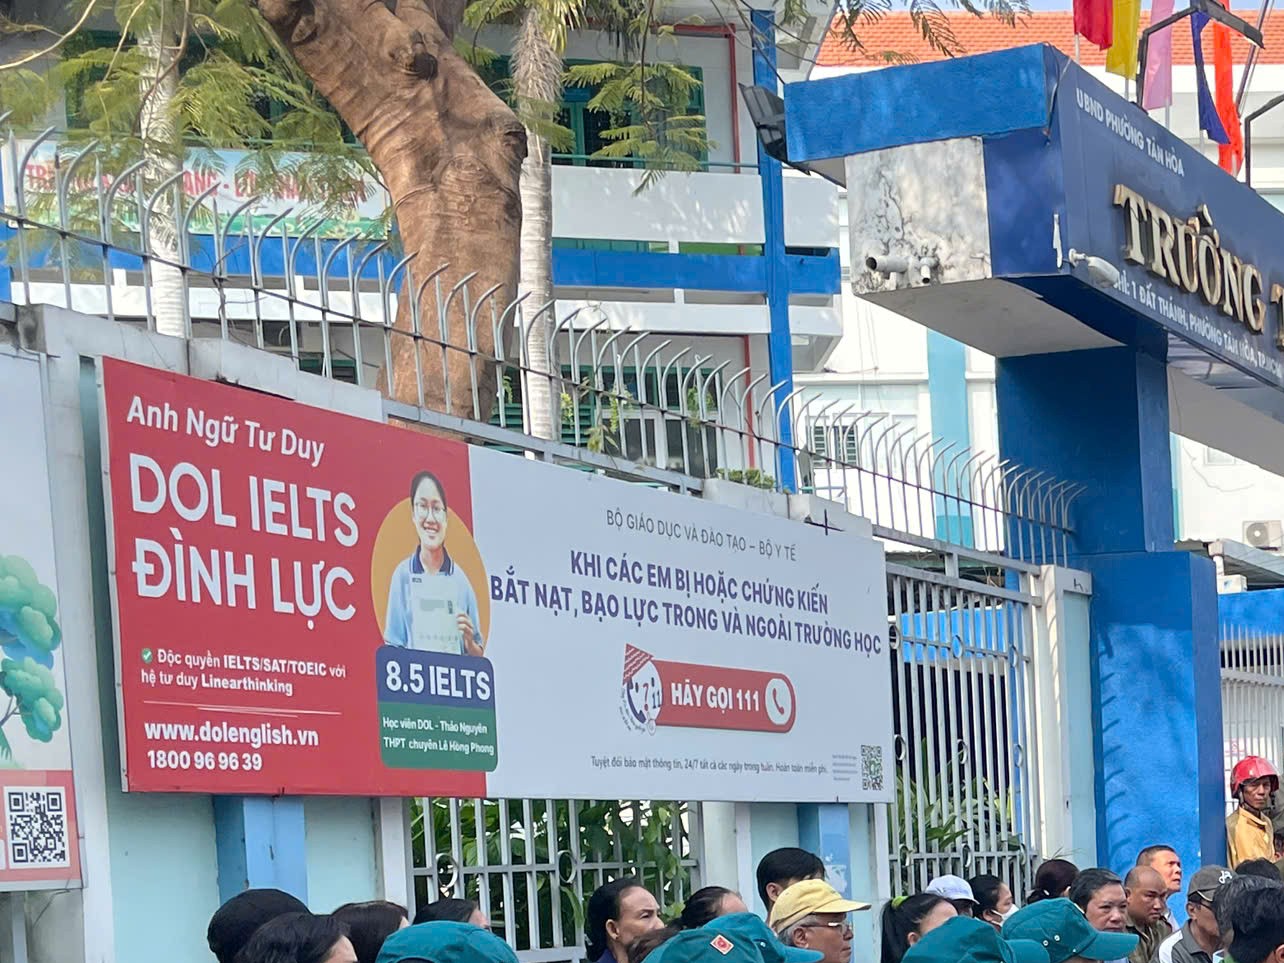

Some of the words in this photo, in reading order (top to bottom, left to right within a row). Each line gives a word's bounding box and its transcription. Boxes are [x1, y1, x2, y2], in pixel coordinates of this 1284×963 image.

[1076, 88, 1104, 122] UBND
[1105, 108, 1144, 150] PHƯỜNG
[1146, 136, 1164, 166] TÂN
[1165, 146, 1184, 177] HÒA
[1113, 184, 1266, 335] TRƯỜNG
[1131, 281, 1137, 299] 1
[1139, 282, 1156, 310] ĐẤT
[1190, 314, 1223, 346] PHƯỜNG
[127, 396, 178, 432] Anh
[186, 408, 238, 447] Ngữ
[245, 420, 275, 451] Tư
[281, 429, 324, 467] Duy
[130, 453, 236, 527] DOL
[249, 476, 358, 547] IELTS
[607, 507, 623, 530] BỘ
[626, 512, 654, 533] GIÁO
[658, 520, 681, 540] DỤC
[684, 523, 698, 541] VÀ
[701, 525, 723, 547] ĐÀO
[727, 533, 746, 553] TẠO
[759, 538, 772, 559] BỘ
[775, 545, 781, 558] Y
[784, 543, 797, 561] TẾ
[132, 527, 256, 609] ĐÌNH
[271, 558, 356, 629] LỰC
[570, 550, 601, 578] KHI
[606, 553, 643, 584] CÁC
[647, 563, 672, 590] EM
[676, 567, 690, 598] BỊ
[694, 570, 737, 603] HOẶC
[742, 577, 794, 609] CHỨNG
[798, 582, 828, 615] KIẾN
[490, 565, 529, 605] BẮT
[582, 590, 619, 622] BẠO
[624, 597, 658, 627] LỰC
[662, 601, 718, 631] TRONG
[722, 607, 743, 635] VÀ
[746, 613, 791, 641] NGOÀI
[795, 620, 851, 650] TRƯỜNG
[854, 631, 881, 658] HỌC
[141, 669, 156, 687] hệ
[159, 672, 173, 685] tư
[176, 672, 198, 690] duy
[202, 673, 293, 696] Linearthinking
[158, 648, 181, 667] Độc
[185, 650, 220, 670] quyền
[223, 654, 326, 676] IELTS/SAT/TOEIC
[329, 664, 346, 678] với
[386, 660, 425, 693] 8.5
[429, 665, 491, 700] IELTS
[671, 679, 703, 707] HÃY
[706, 685, 733, 714] GỌI
[736, 689, 759, 711] 111
[144, 721, 319, 749] www.dolenglish.vn
[382, 716, 398, 731] Học
[417, 719, 434, 730] DOL
[440, 720, 459, 732] Thảo
[460, 722, 488, 736] Nguyên
[383, 736, 406, 749] THPT
[408, 739, 438, 752] chuyên
[439, 739, 448, 751] Lê
[471, 742, 494, 756] Phong
[147, 750, 191, 769] 1800
[194, 752, 215, 770] 96
[218, 752, 239, 770] 96
[242, 752, 263, 771] 39
[591, 755, 611, 770] Tuyệt
[684, 758, 698, 770] 24/7
[744, 762, 760, 774] trong
